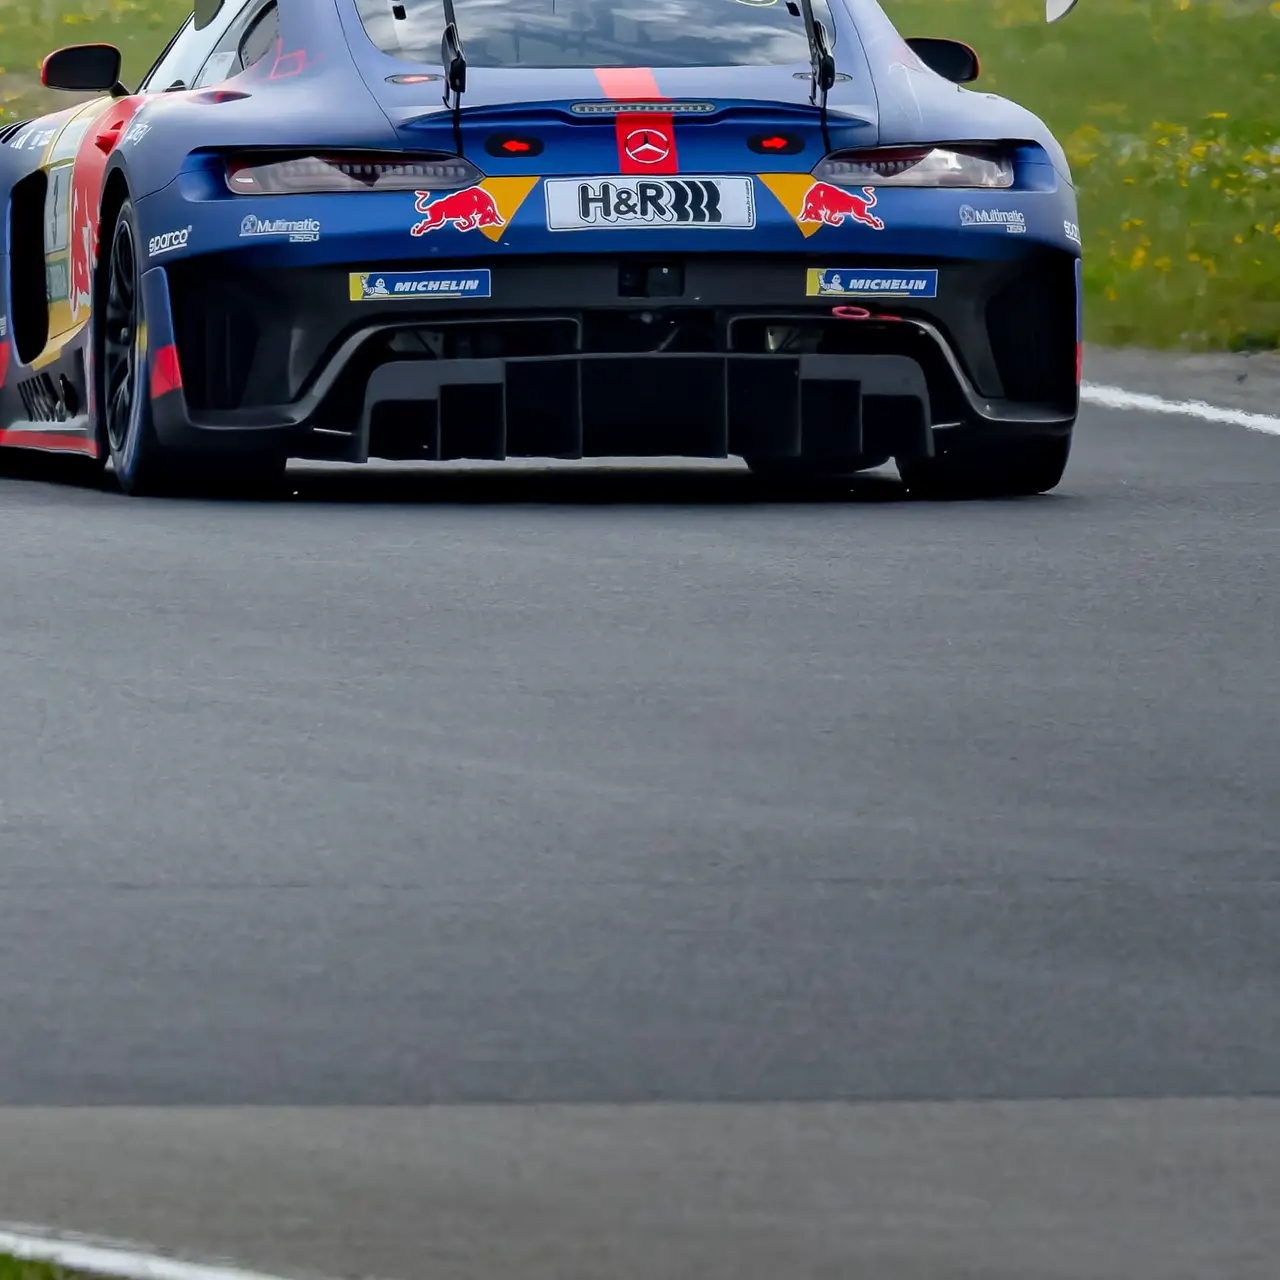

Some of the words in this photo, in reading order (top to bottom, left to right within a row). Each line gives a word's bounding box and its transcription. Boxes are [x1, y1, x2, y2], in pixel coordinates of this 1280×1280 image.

[577, 181, 674, 223] H&R
[975, 208, 1025, 222] Multimatic
[257, 218, 321, 234] Multimatic
[148, 227, 189, 256] sparco
[394, 279, 480, 292] MICHELIN
[848, 279, 928, 291] MICHELIN
